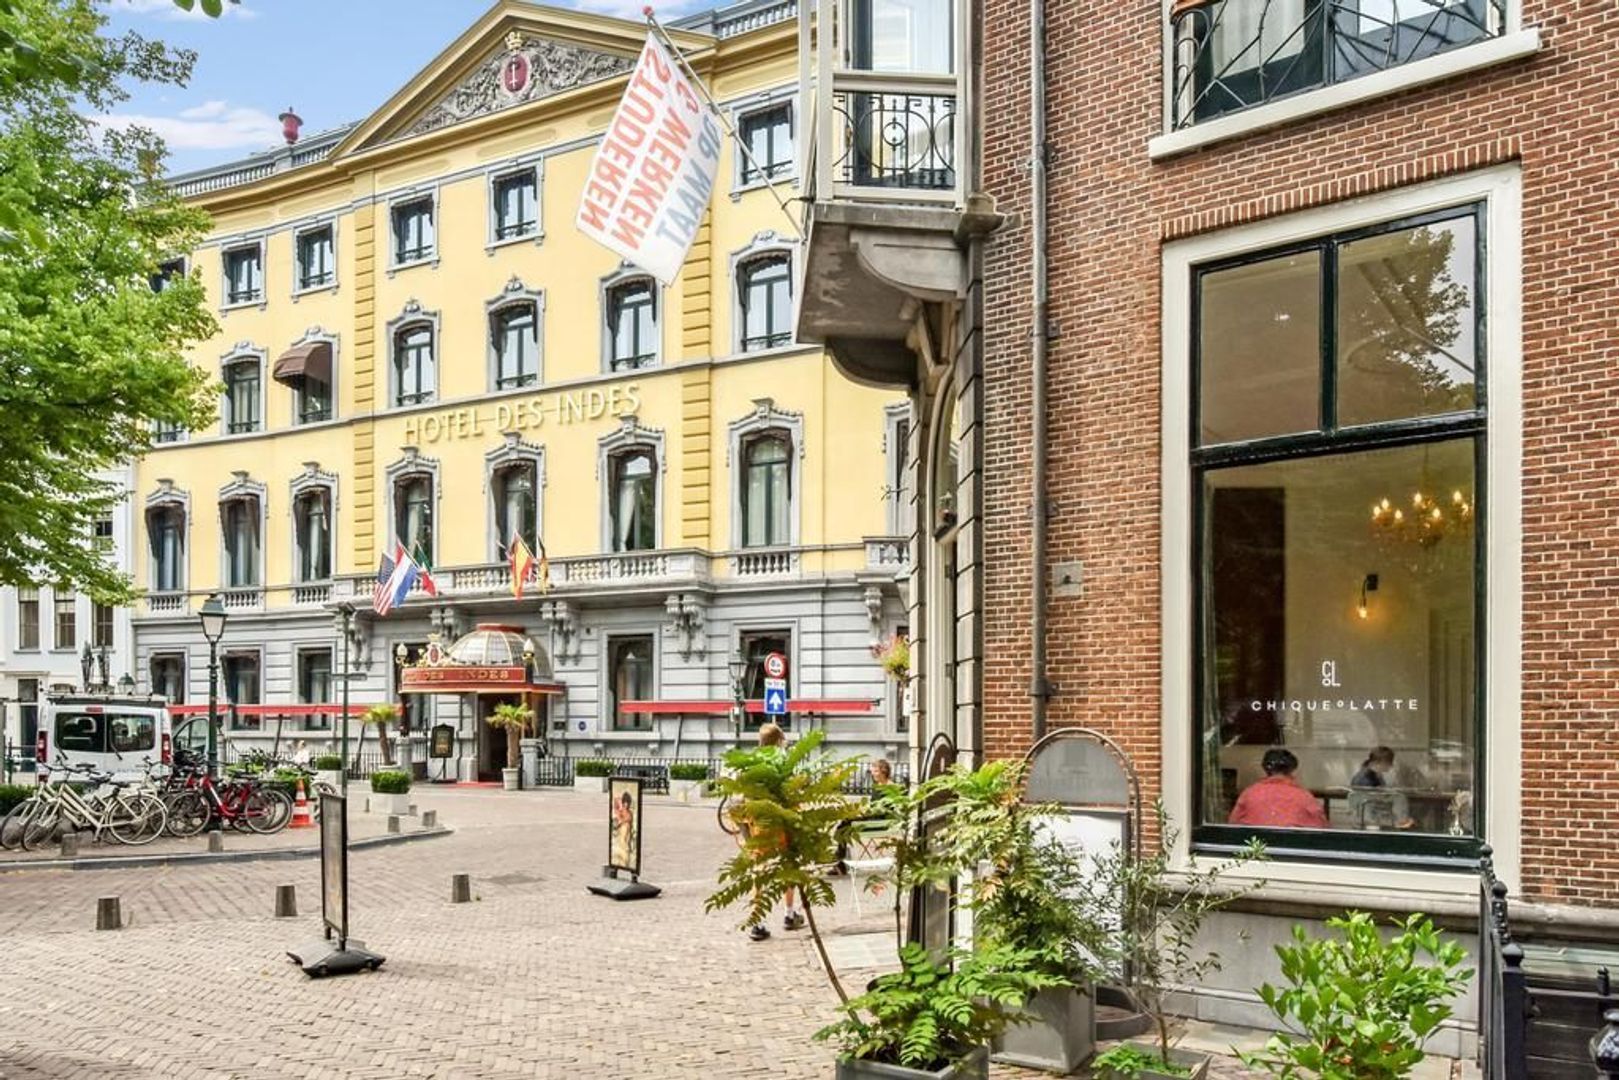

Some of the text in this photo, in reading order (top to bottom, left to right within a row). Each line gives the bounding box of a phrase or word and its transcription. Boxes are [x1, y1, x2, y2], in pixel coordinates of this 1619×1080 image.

[404, 382, 641, 445] HOTEL DES INDES
